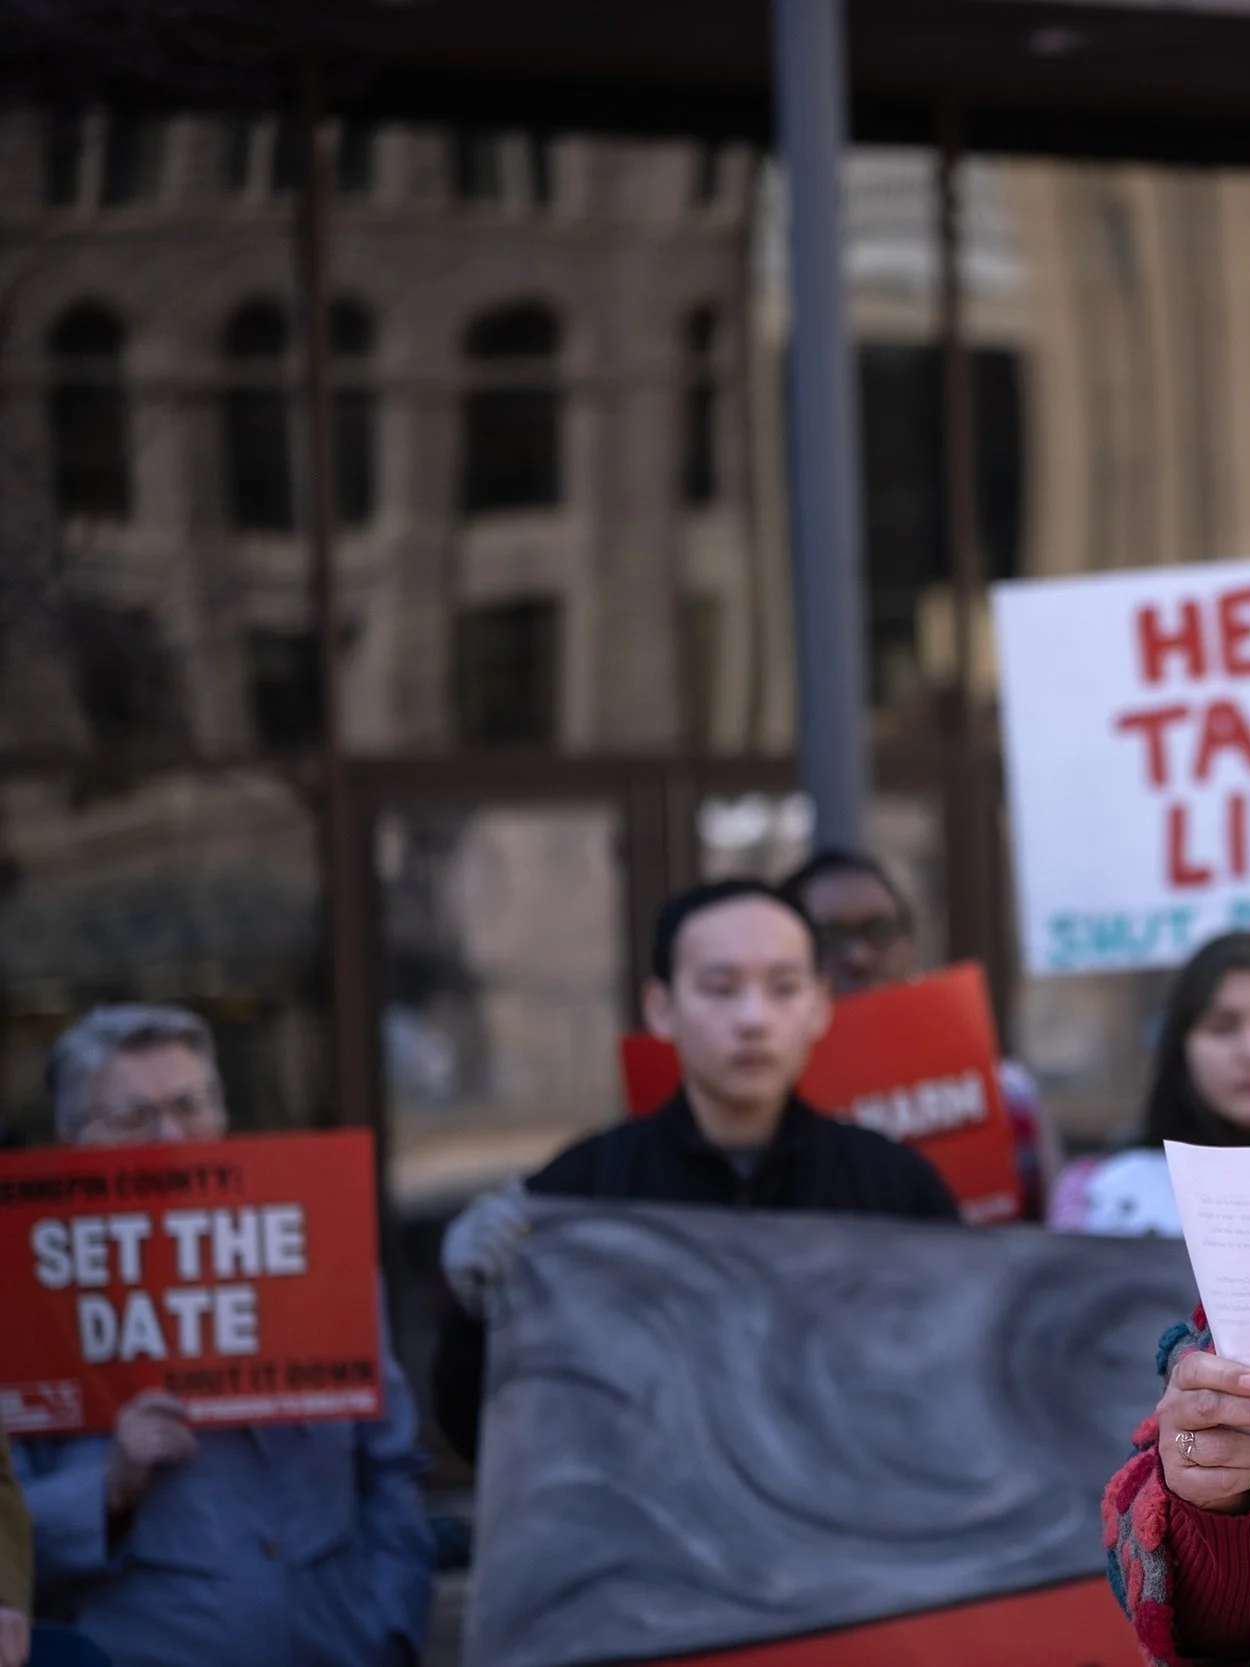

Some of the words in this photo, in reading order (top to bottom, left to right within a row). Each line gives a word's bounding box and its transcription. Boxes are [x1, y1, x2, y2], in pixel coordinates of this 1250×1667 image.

[31, 1212, 152, 1290] SET
[163, 1203, 308, 1281] THE
[77, 1287, 259, 1363] DATE
